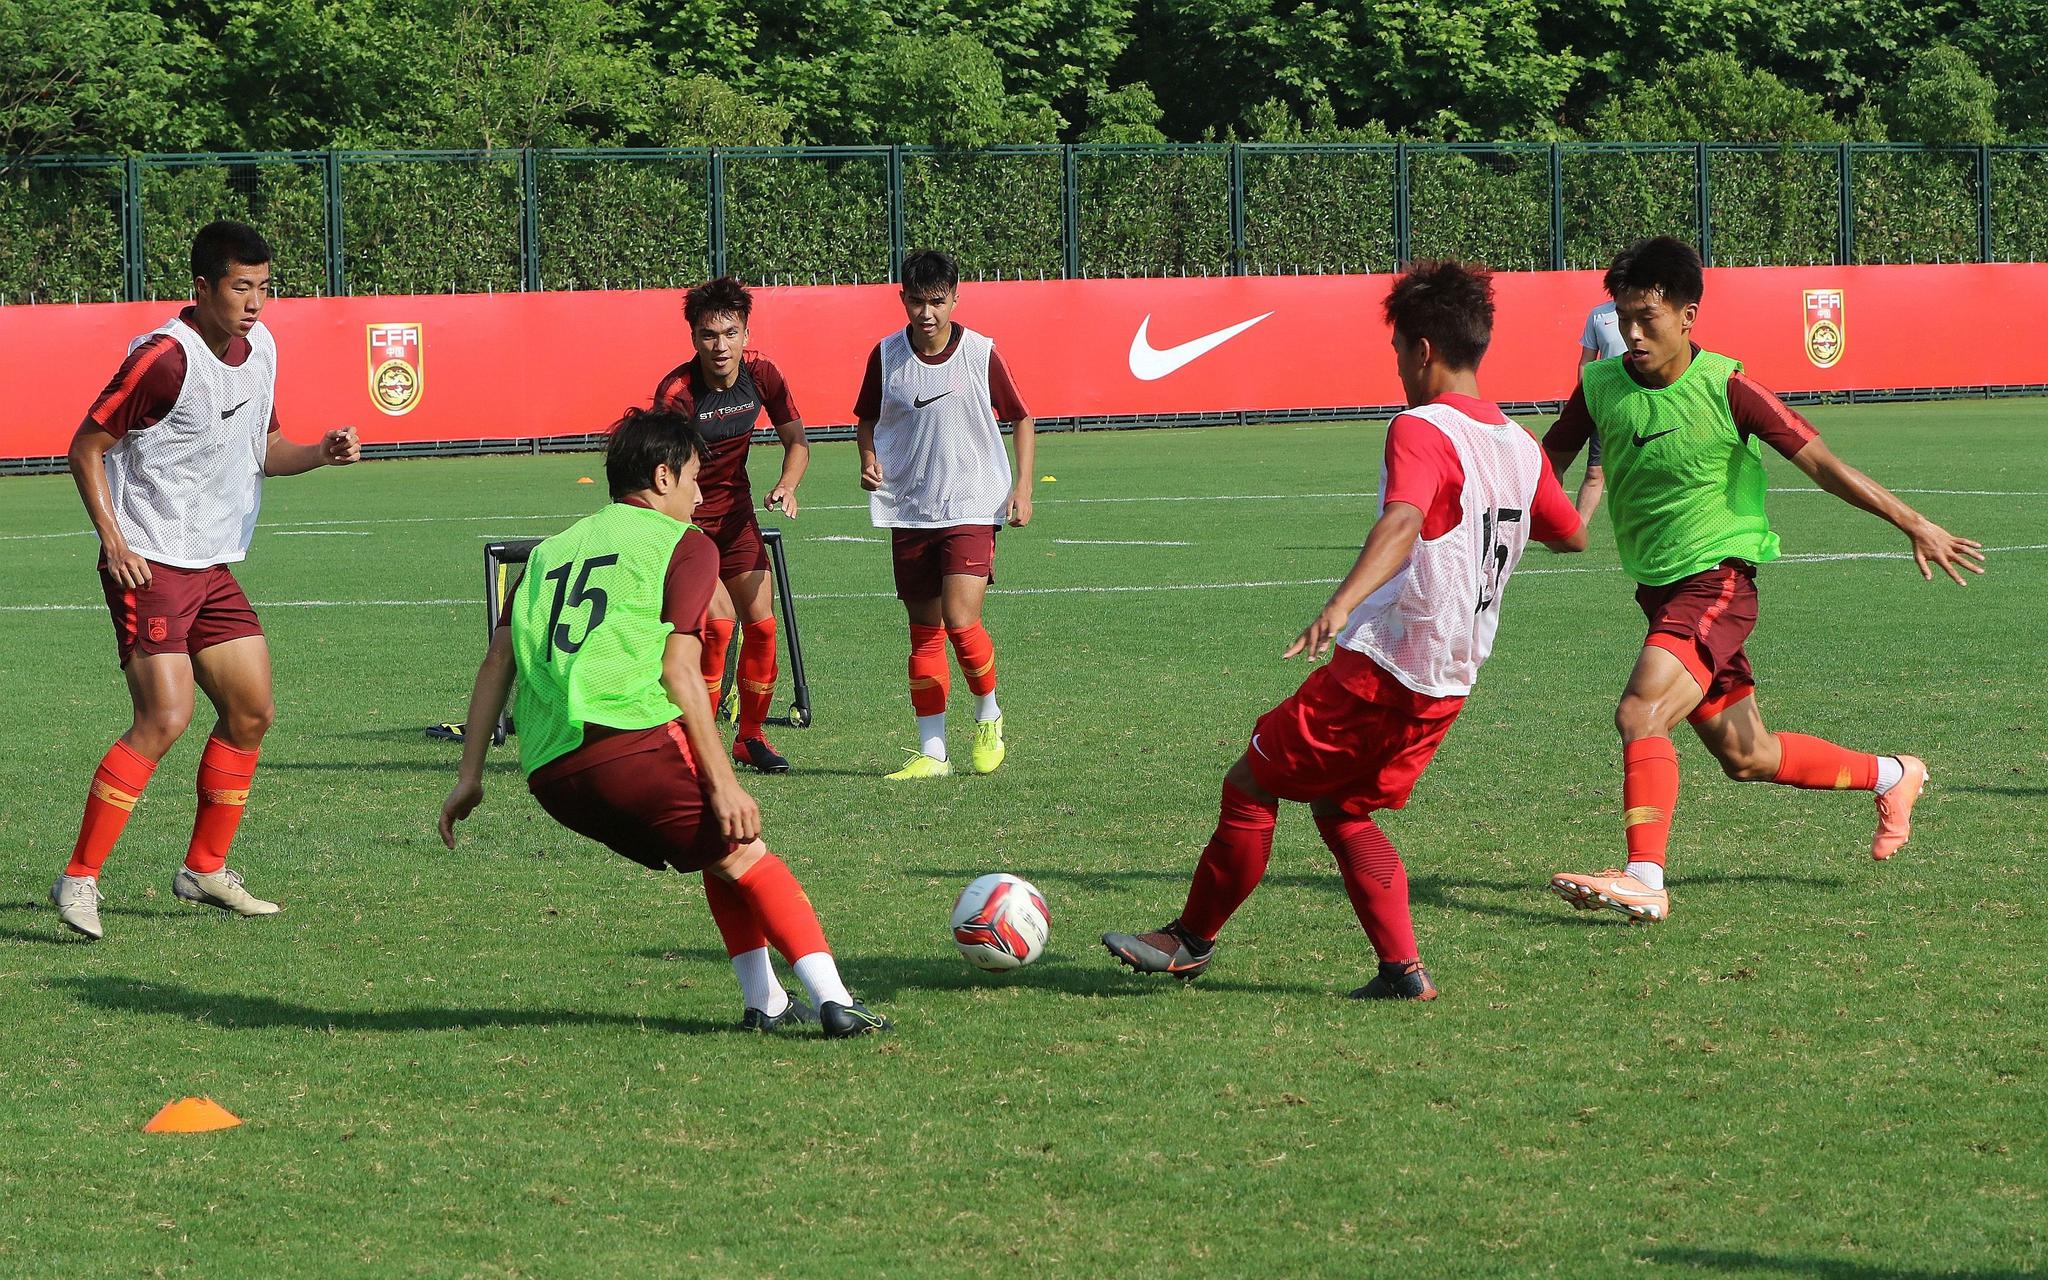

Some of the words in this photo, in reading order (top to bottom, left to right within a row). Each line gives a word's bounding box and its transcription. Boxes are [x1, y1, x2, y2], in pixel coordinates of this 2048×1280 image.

[1806, 294, 1841, 309] CFA
[372, 329, 418, 347] CFA
[545, 553, 620, 663] 15
